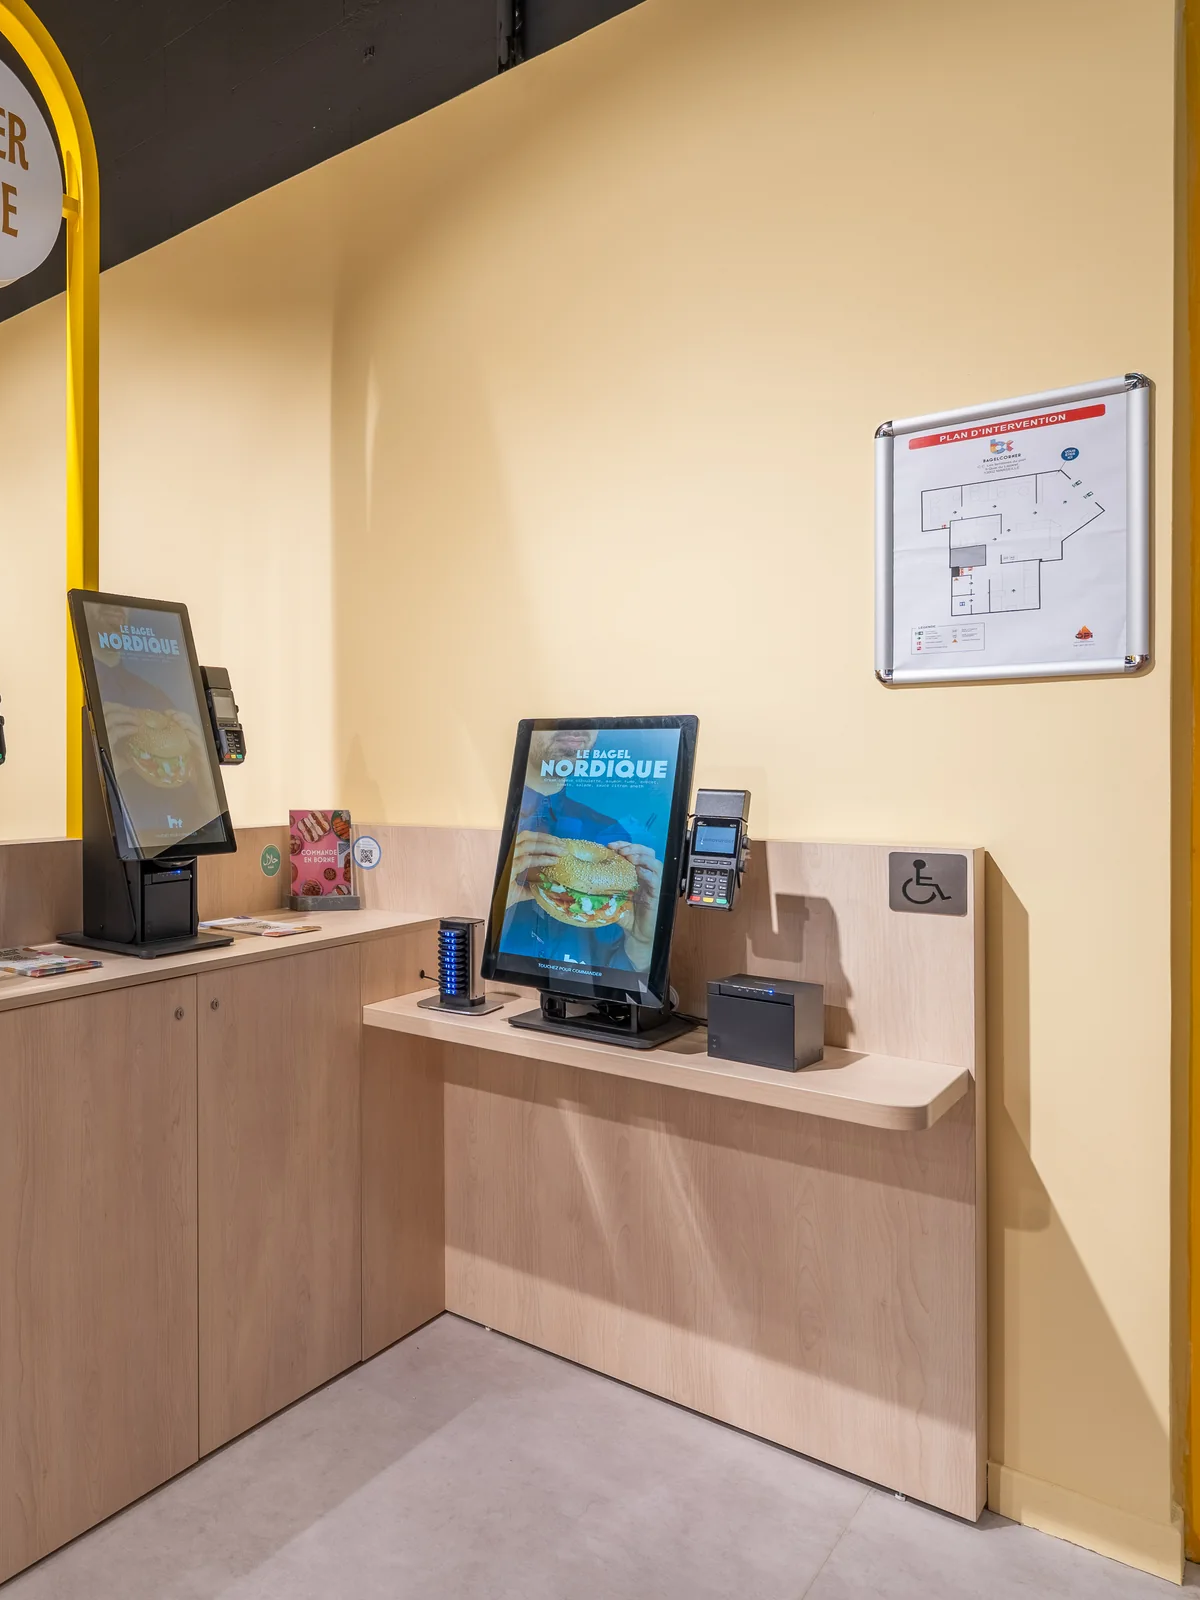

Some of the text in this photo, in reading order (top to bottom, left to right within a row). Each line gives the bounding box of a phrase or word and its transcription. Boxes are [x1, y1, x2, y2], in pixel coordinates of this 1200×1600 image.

[939, 413, 1067, 443] PLAN D'INTERVENTION
[983, 453, 1022, 463] BAGELCORNER
[119, 624, 156, 637] LE BAGEL
[98, 631, 180, 656] NORDIQUE
[576, 749, 631, 759] LE BAGEL
[540, 759, 669, 779] NORDIQUE
[538, 962, 558, 970] TOUCHEZ
